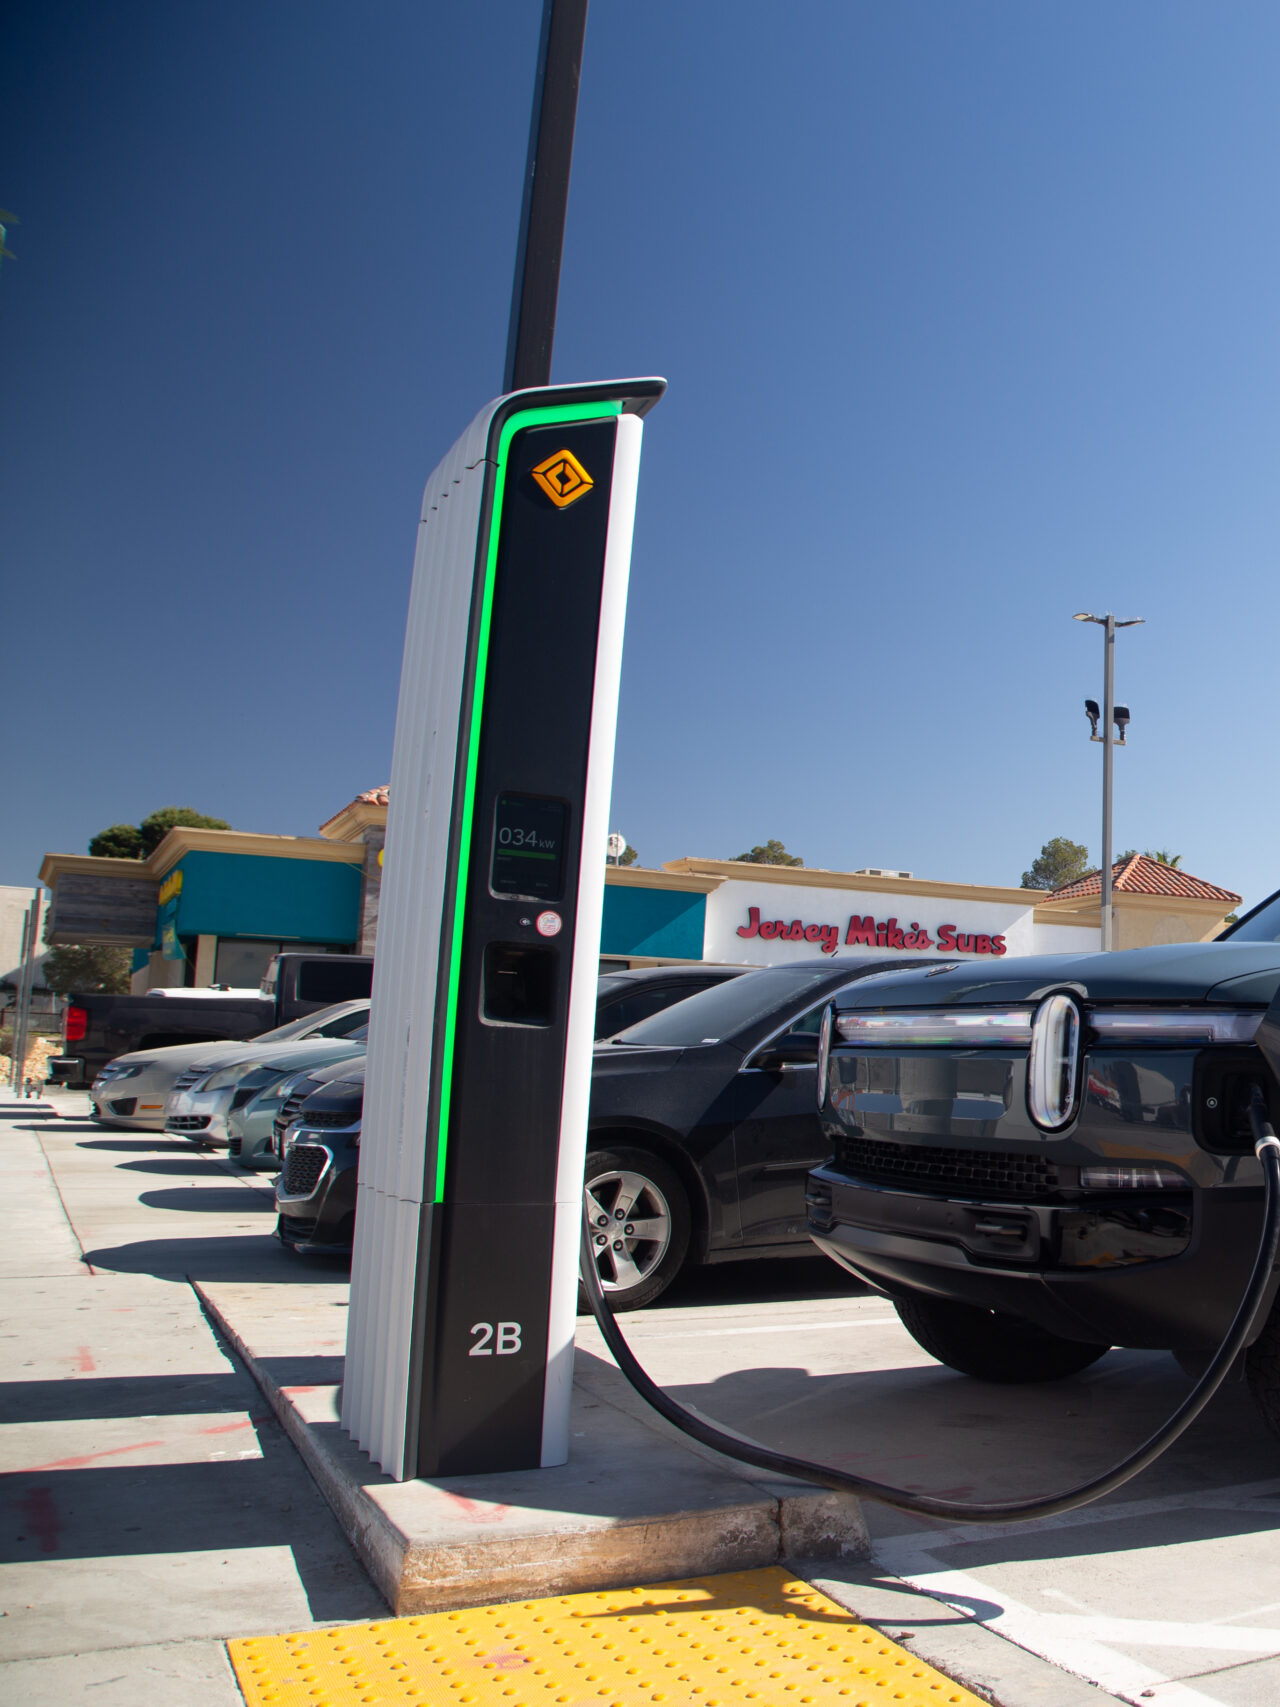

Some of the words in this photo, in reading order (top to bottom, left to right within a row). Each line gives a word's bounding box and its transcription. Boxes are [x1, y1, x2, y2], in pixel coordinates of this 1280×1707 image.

[499, 827, 538, 847] 034
[539, 839, 556, 849] kW
[736, 906, 839, 953] Jersey
[845, 914, 935, 950] Mike's
[468, 1321, 522, 1357] 2B
